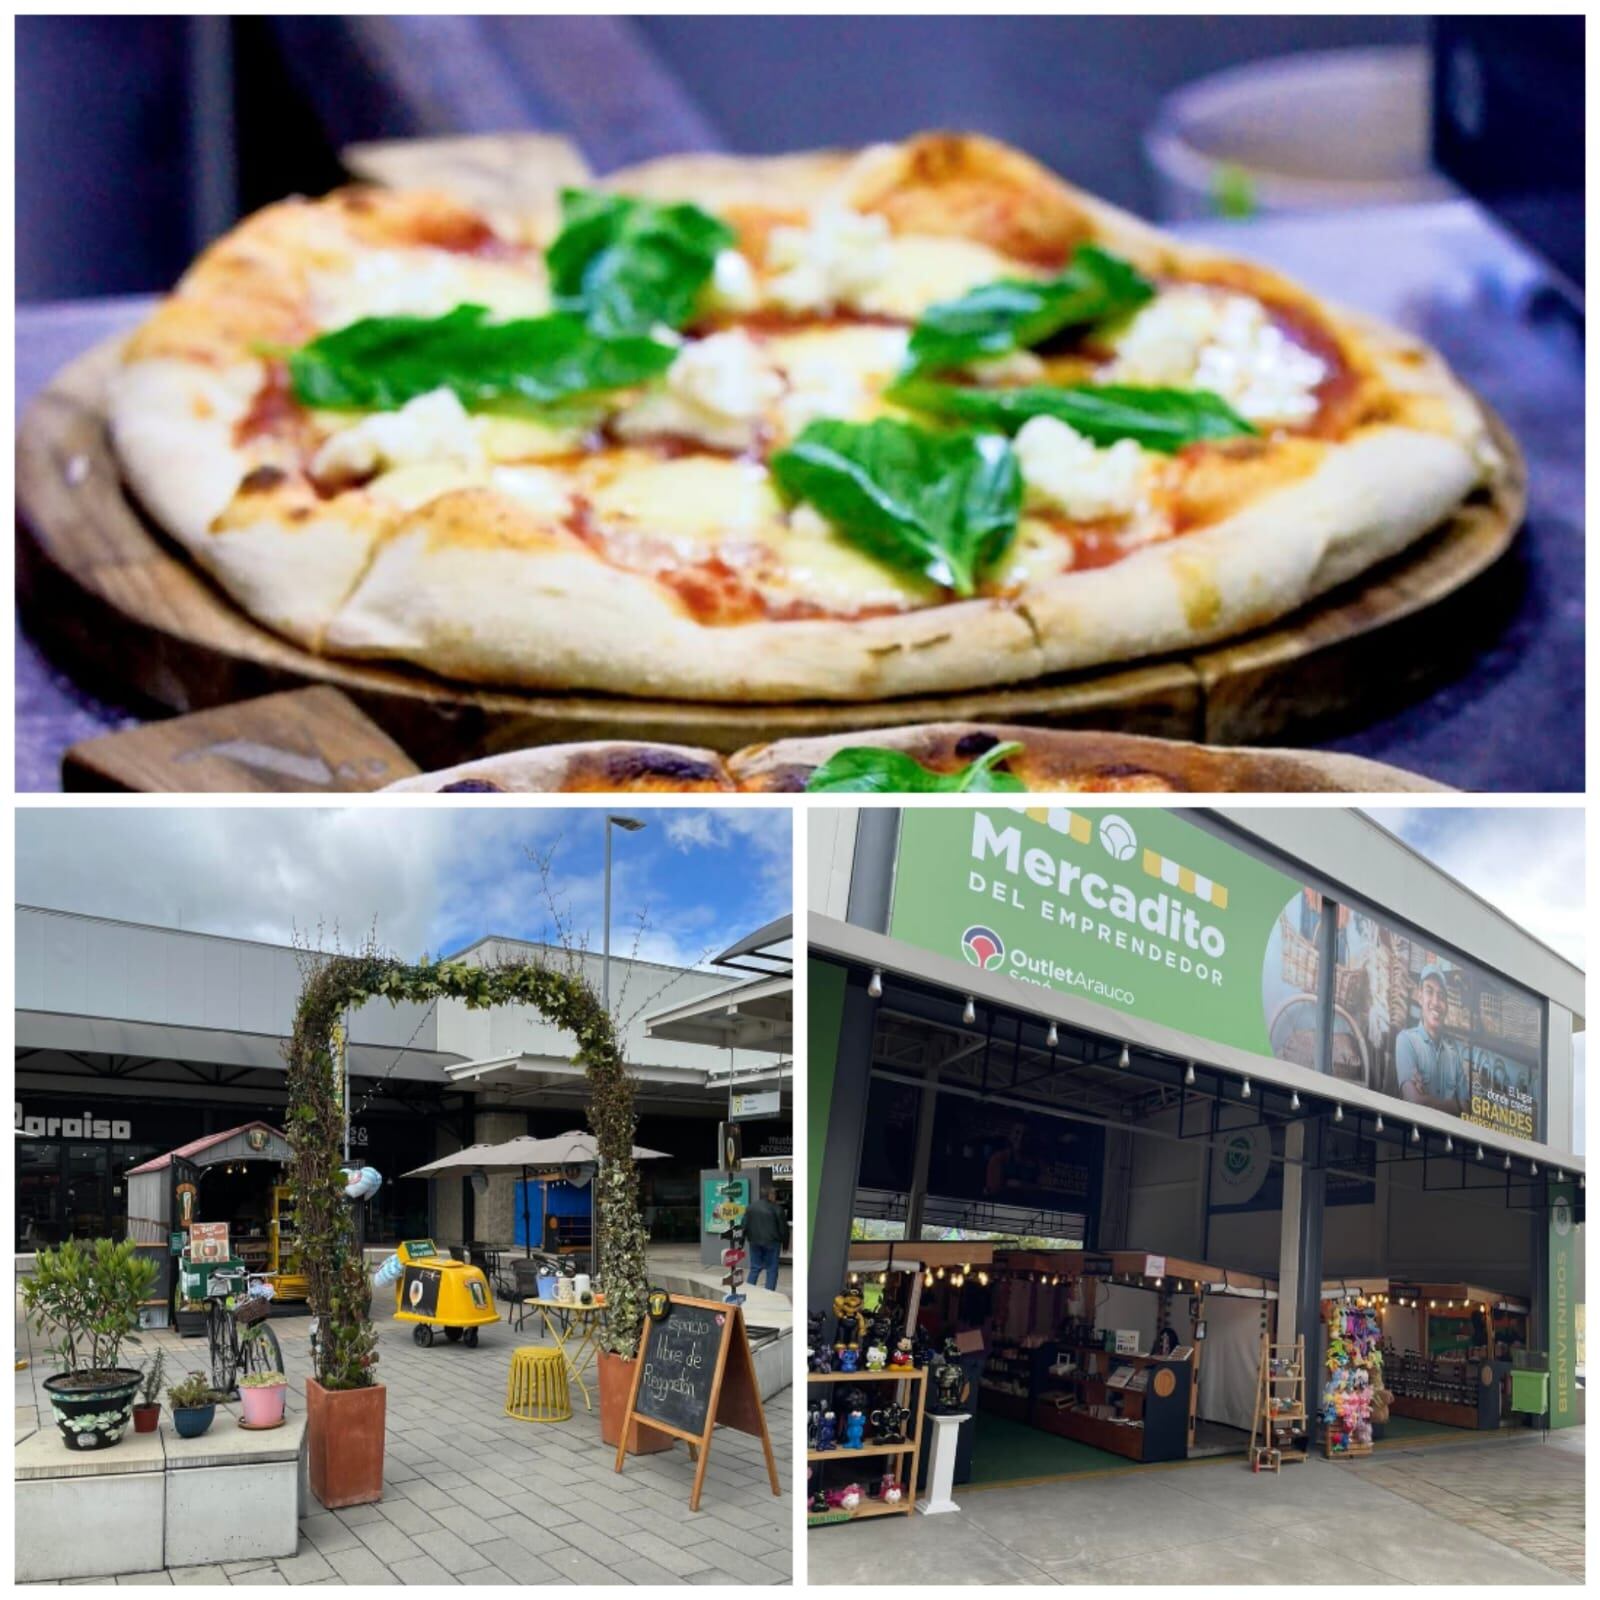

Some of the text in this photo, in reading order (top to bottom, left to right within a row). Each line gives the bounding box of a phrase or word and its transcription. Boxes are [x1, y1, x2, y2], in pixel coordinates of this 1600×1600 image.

[971, 811, 1226, 958] Mercadito
[968, 871, 1224, 987] DEL EMPRENDEDOR
[1010, 949, 1135, 1005] OutletArauco
[1471, 1095, 1533, 1133] GRANDES
[686, 1341, 702, 1369] de
[1557, 1250, 1568, 1413] BIENVENIDOS
